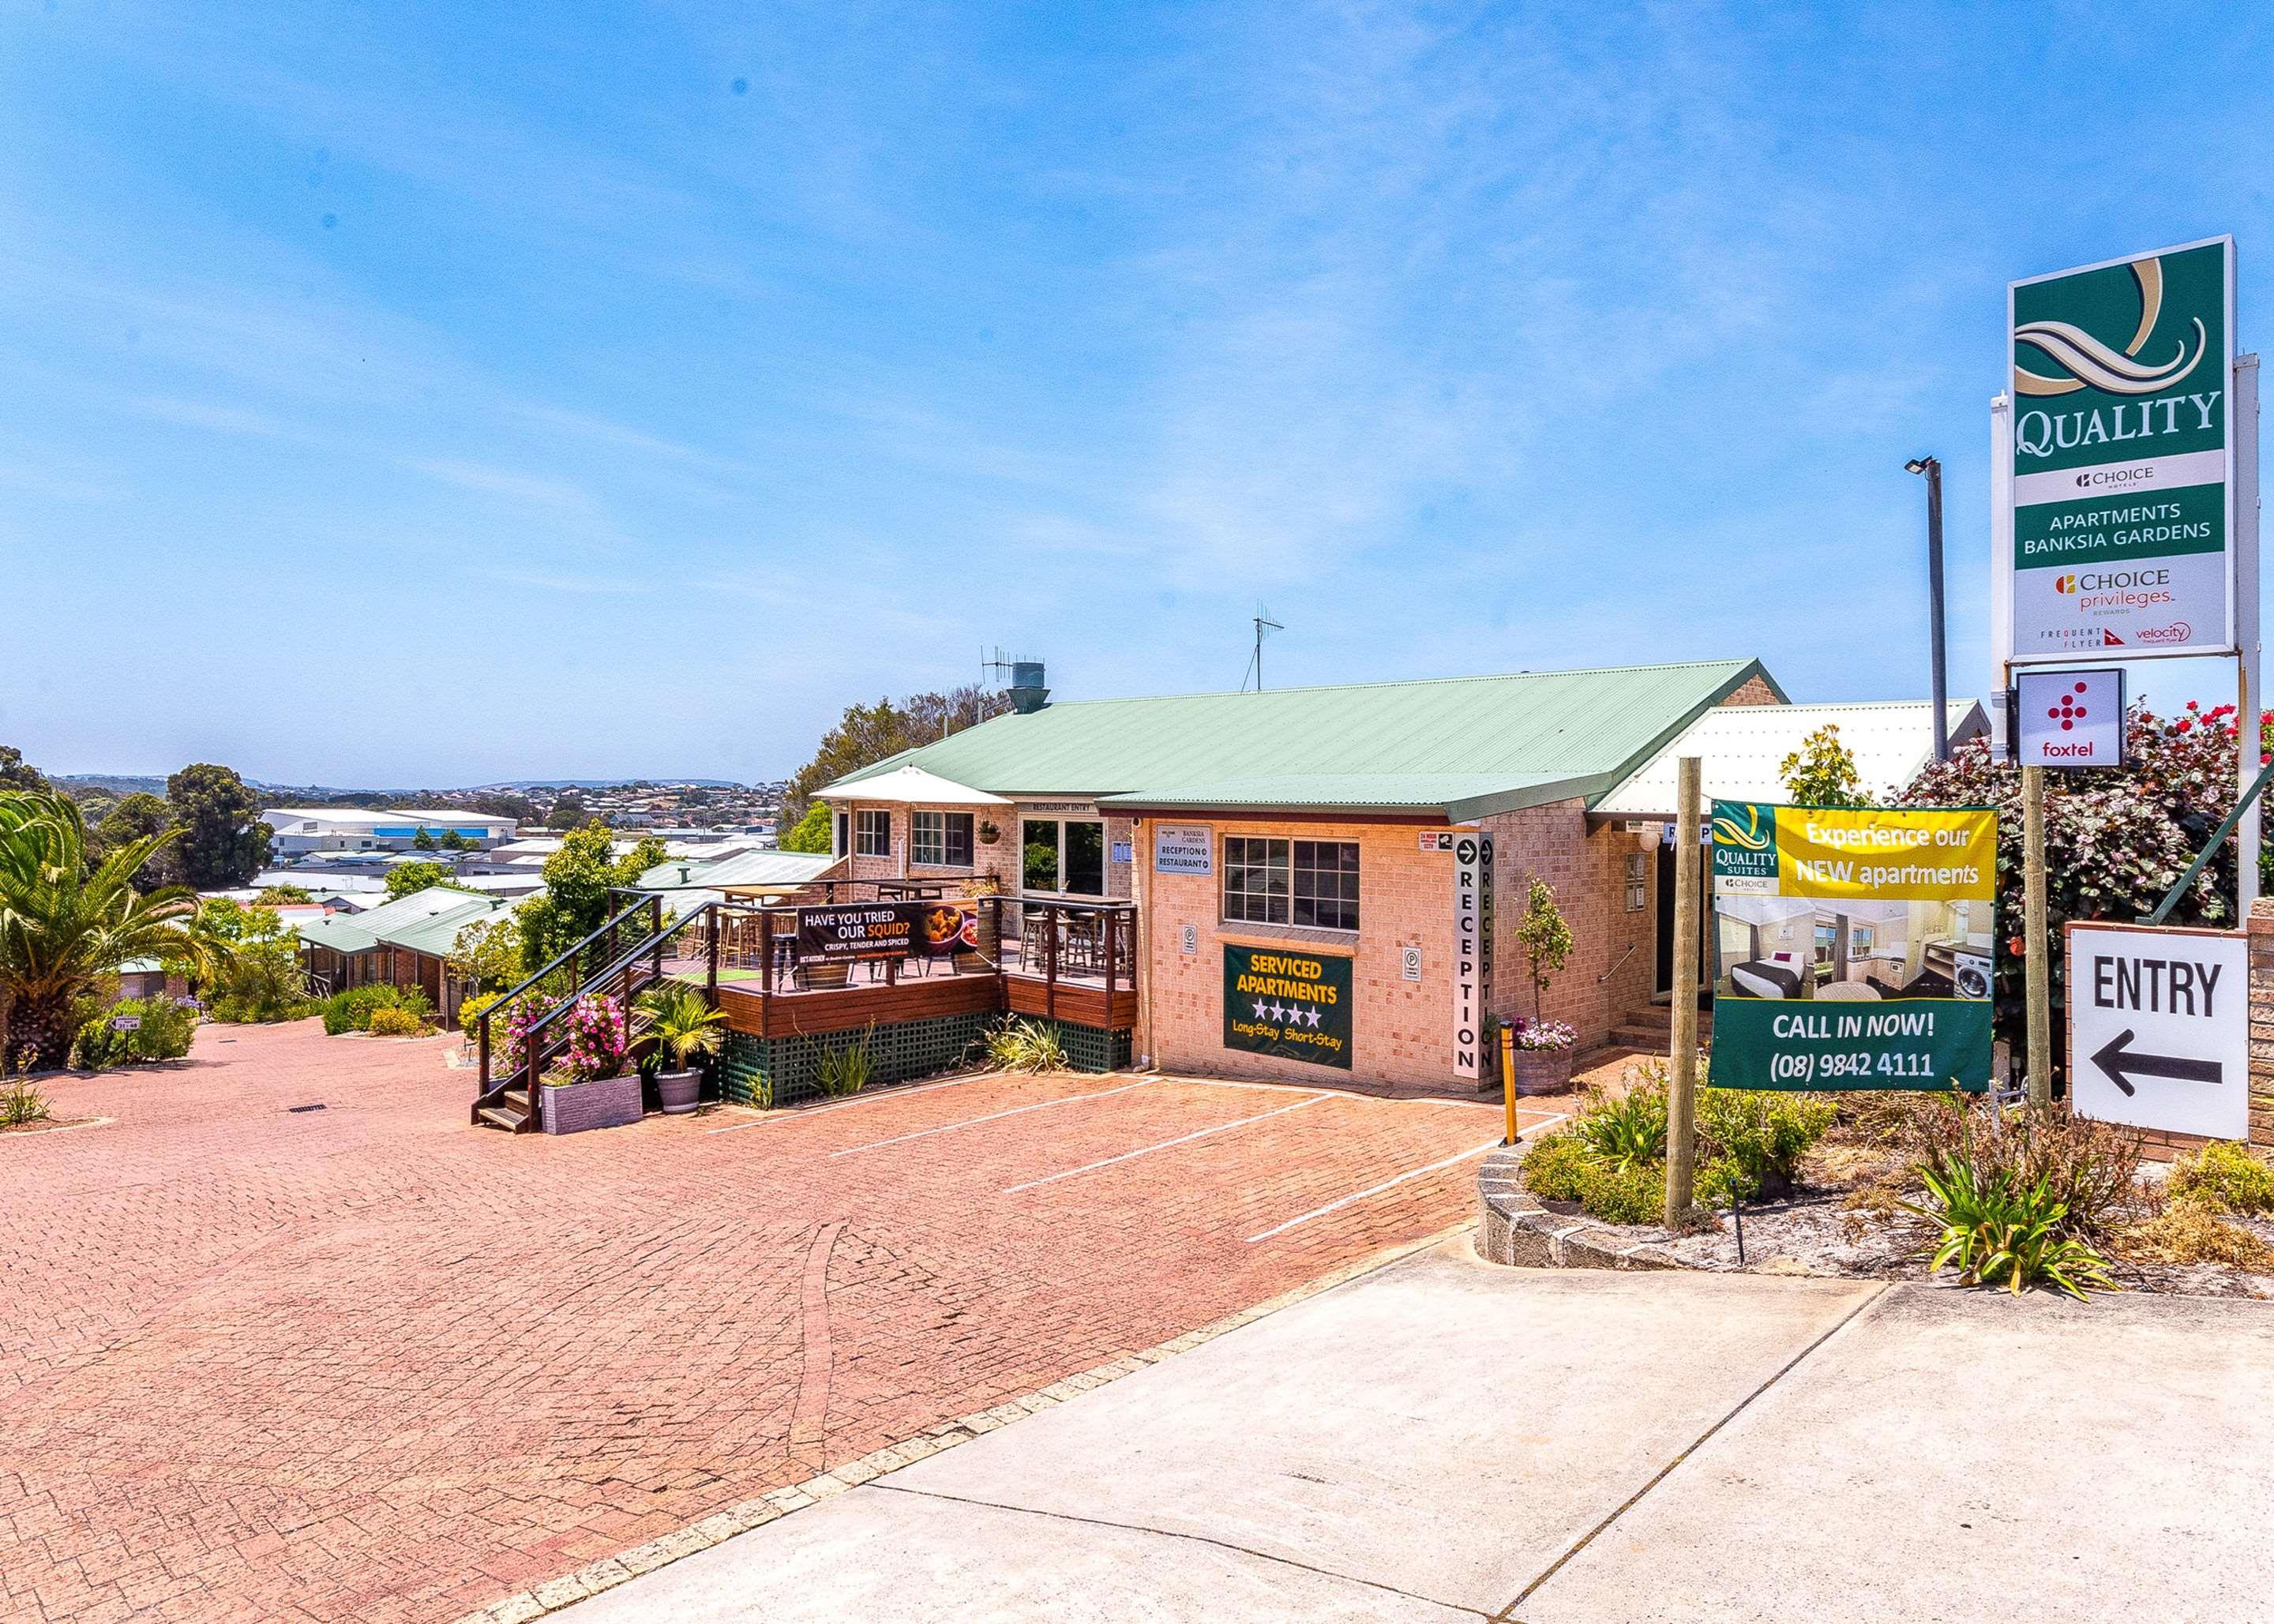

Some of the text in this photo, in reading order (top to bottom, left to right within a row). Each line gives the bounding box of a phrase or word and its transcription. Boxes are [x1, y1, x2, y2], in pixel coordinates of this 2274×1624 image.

[2016, 392, 2221, 458] QUALITY
[2092, 467, 2154, 485] CHOICE
[2050, 503, 2181, 531] APARTMENTS
[2024, 522, 2211, 554] BANKSIA GARDENS
[2081, 569, 2170, 591] CHOICE
[2041, 628, 2101, 639] FREQUENT
[2136, 622, 2191, 643] velocity
[2064, 639, 2101, 648] FLYER
[2042, 741, 2093, 757] foxtel
[1033, 802, 1069, 811] RESTAURANT
[1807, 823, 1970, 847] Experience our
[1161, 846, 1201, 855] RECEPTION
[1716, 849, 1777, 867] QUALITY
[1158, 857, 1202, 868] RESTAURANT
[1727, 866, 1766, 876] SUITES
[1735, 878, 1768, 889] CHOICE
[1795, 860, 1979, 889] NEW apartments
[805, 910, 895, 927] HAVE YOU TRIED
[838, 922, 910, 940] OUR SQUID?
[850, 940, 874, 950] TENDER
[887, 937, 909, 947] SPICED
[1251, 954, 1323, 980] SERVICED
[1458, 871, 1474, 1068] RECEPTION
[1480, 872, 1492, 1067] RECEPTION
[1236, 974, 1337, 1004] APARTMENTS
[2094, 955, 2223, 1018] ENTRY
[1233, 1019, 1342, 1052] Long-Stay Short-Stay
[1773, 1012, 1934, 1039] CALL IN NOW!
[1769, 1052, 1934, 1082] (08) 9842 4111
